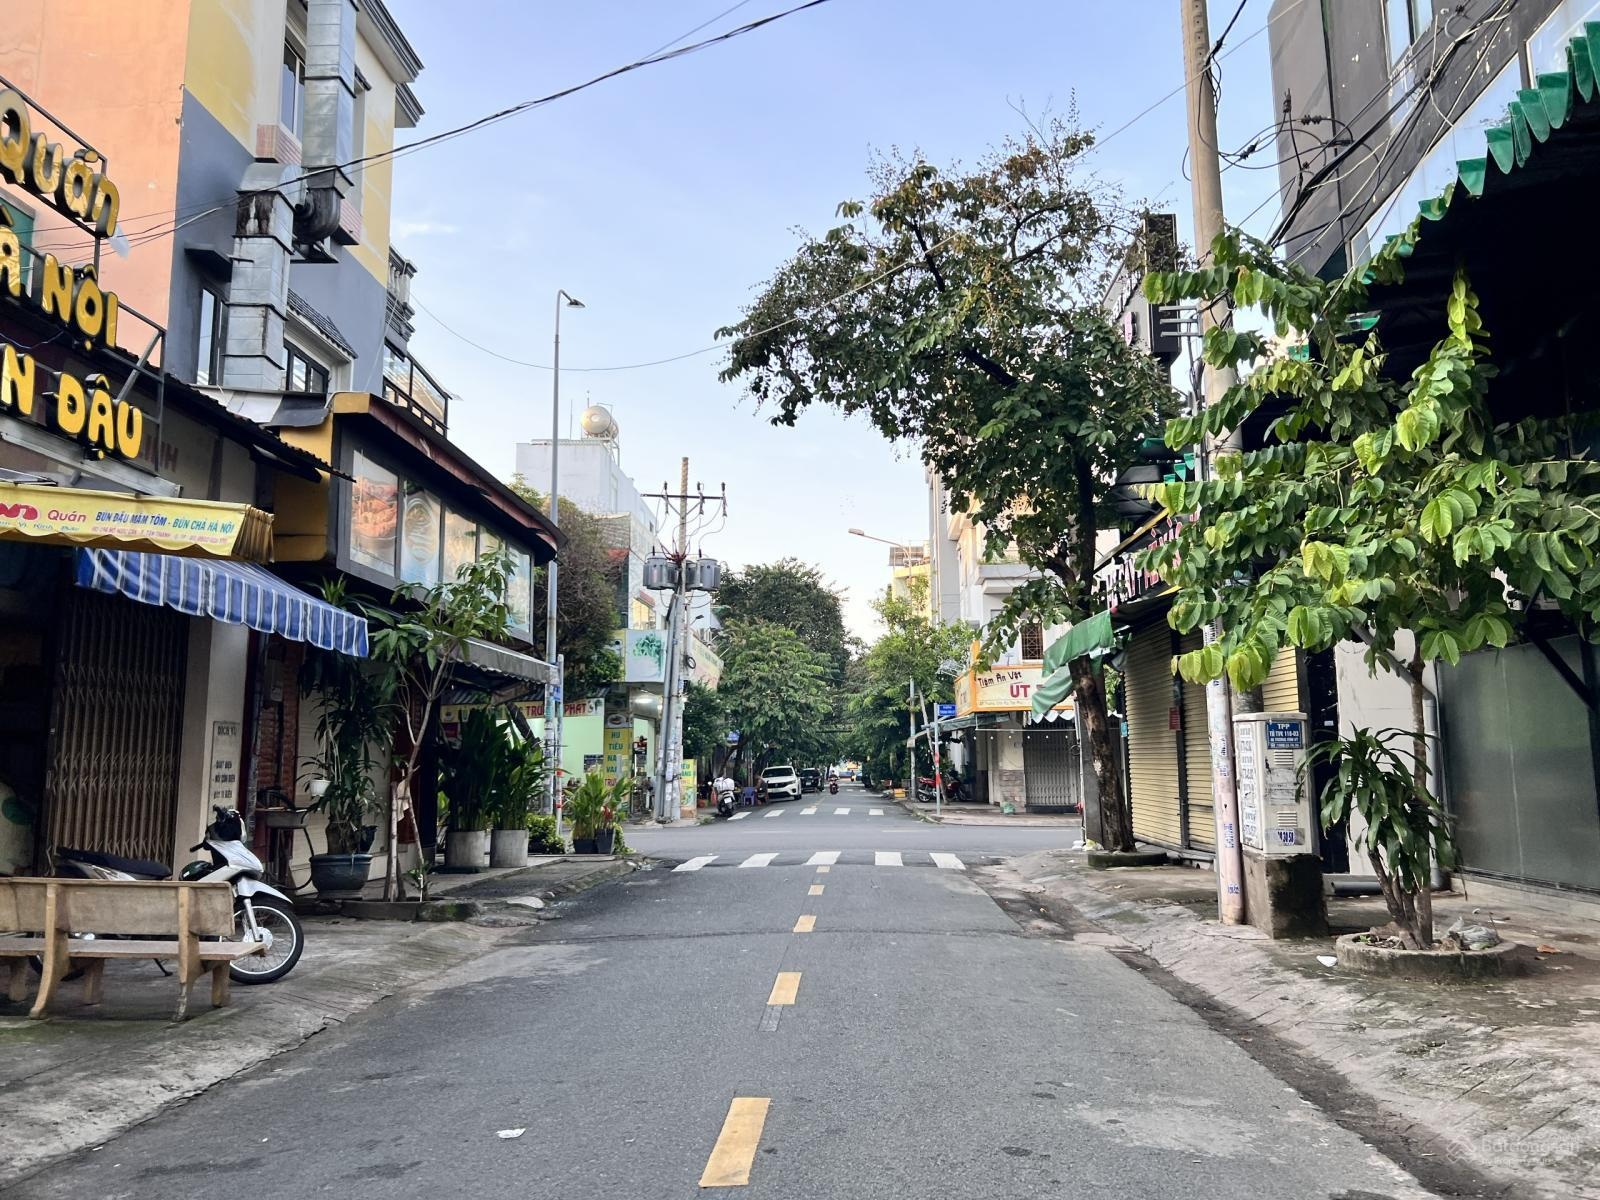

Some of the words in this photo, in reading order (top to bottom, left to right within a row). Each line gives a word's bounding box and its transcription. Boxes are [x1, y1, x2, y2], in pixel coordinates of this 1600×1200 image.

[42, 253, 118, 351] NỘI
[43, 375, 143, 459] ĐẬU
[47, 509, 88, 523] Quán
